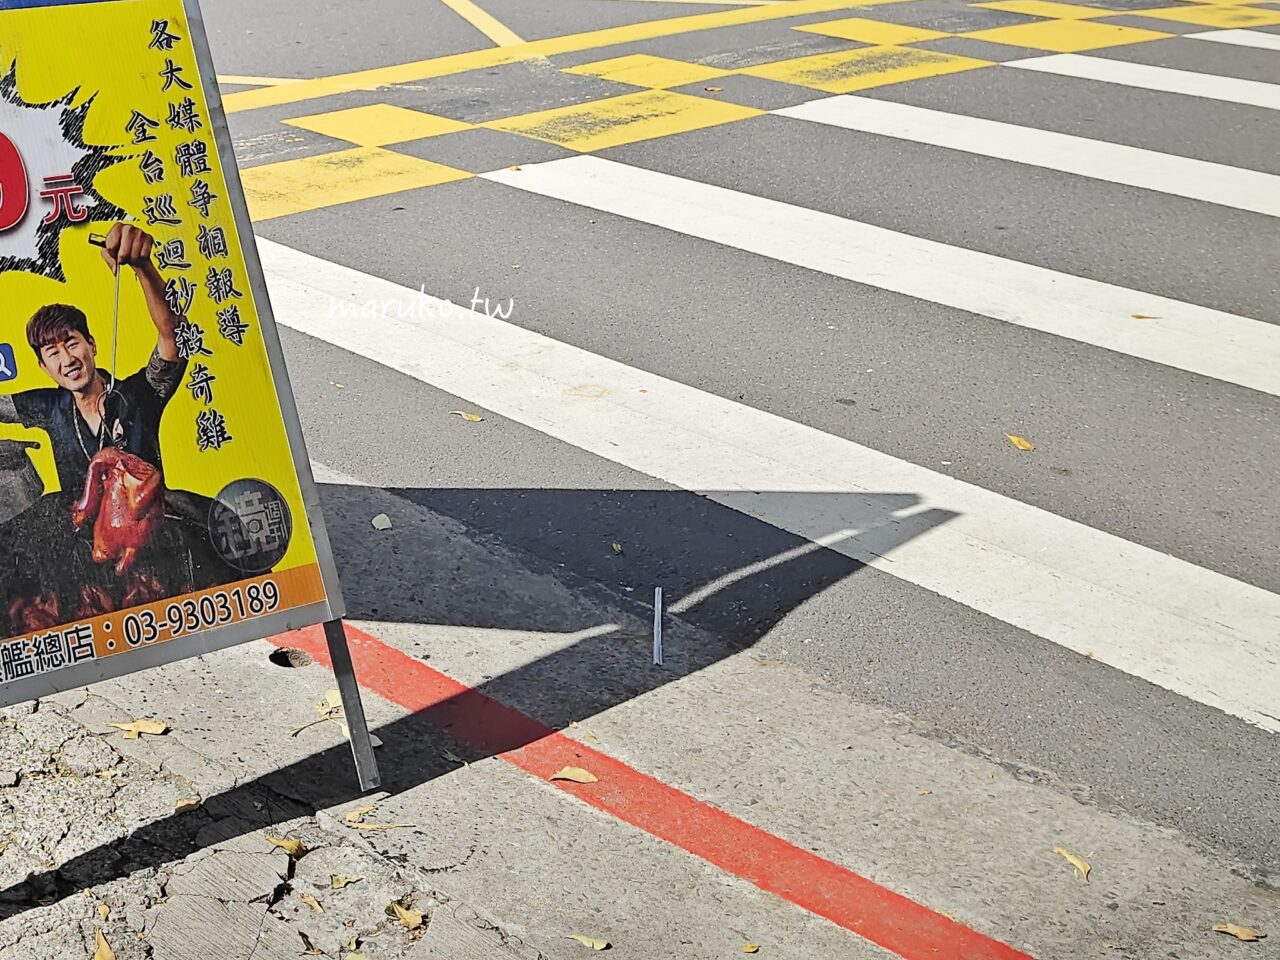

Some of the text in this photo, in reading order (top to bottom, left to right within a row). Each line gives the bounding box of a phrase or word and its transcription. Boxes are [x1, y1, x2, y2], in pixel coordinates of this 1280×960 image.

[125, 109, 233, 452] 全台巡迴秒殺奇雞
[149, 19, 251, 346] 各大媒體爭相報導
